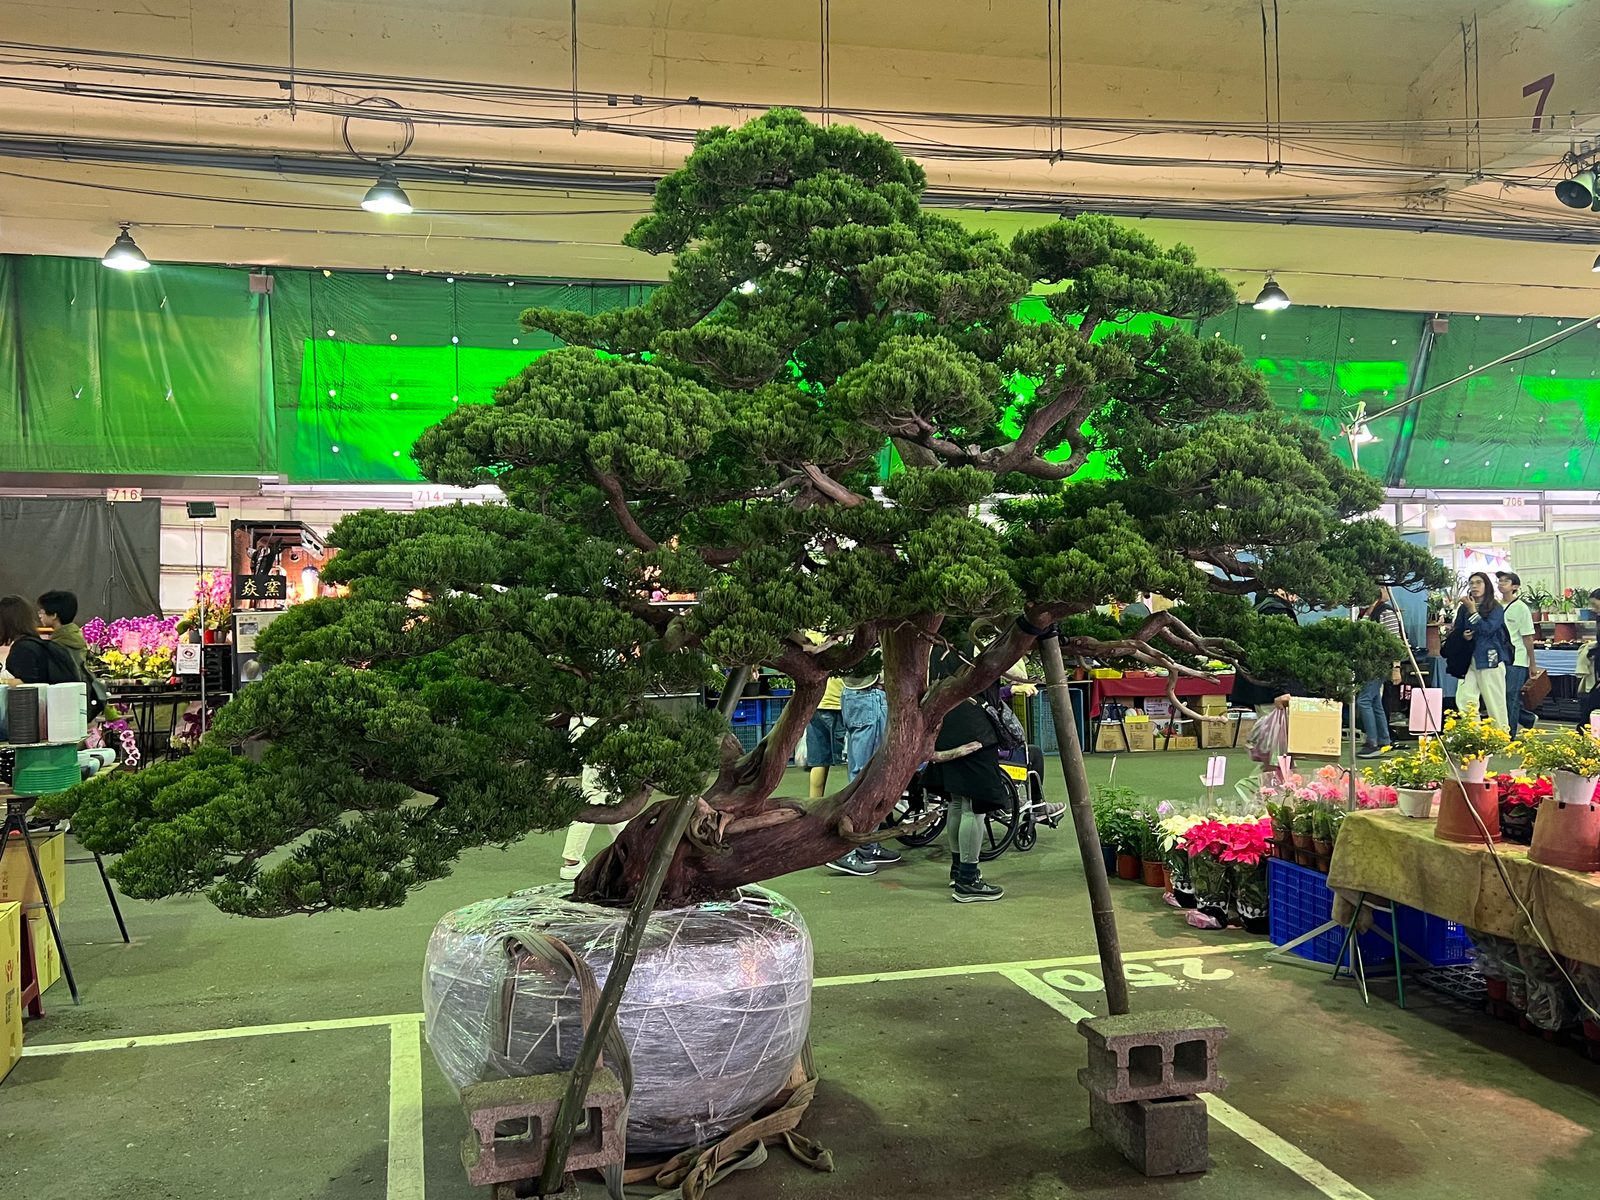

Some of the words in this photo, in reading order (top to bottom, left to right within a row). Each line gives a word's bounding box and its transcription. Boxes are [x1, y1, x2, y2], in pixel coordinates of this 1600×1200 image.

[1523, 72, 1555, 133] 7
[112, 489, 138, 500] 716
[417, 491, 440, 501] 714
[1506, 497, 1523, 506] 706
